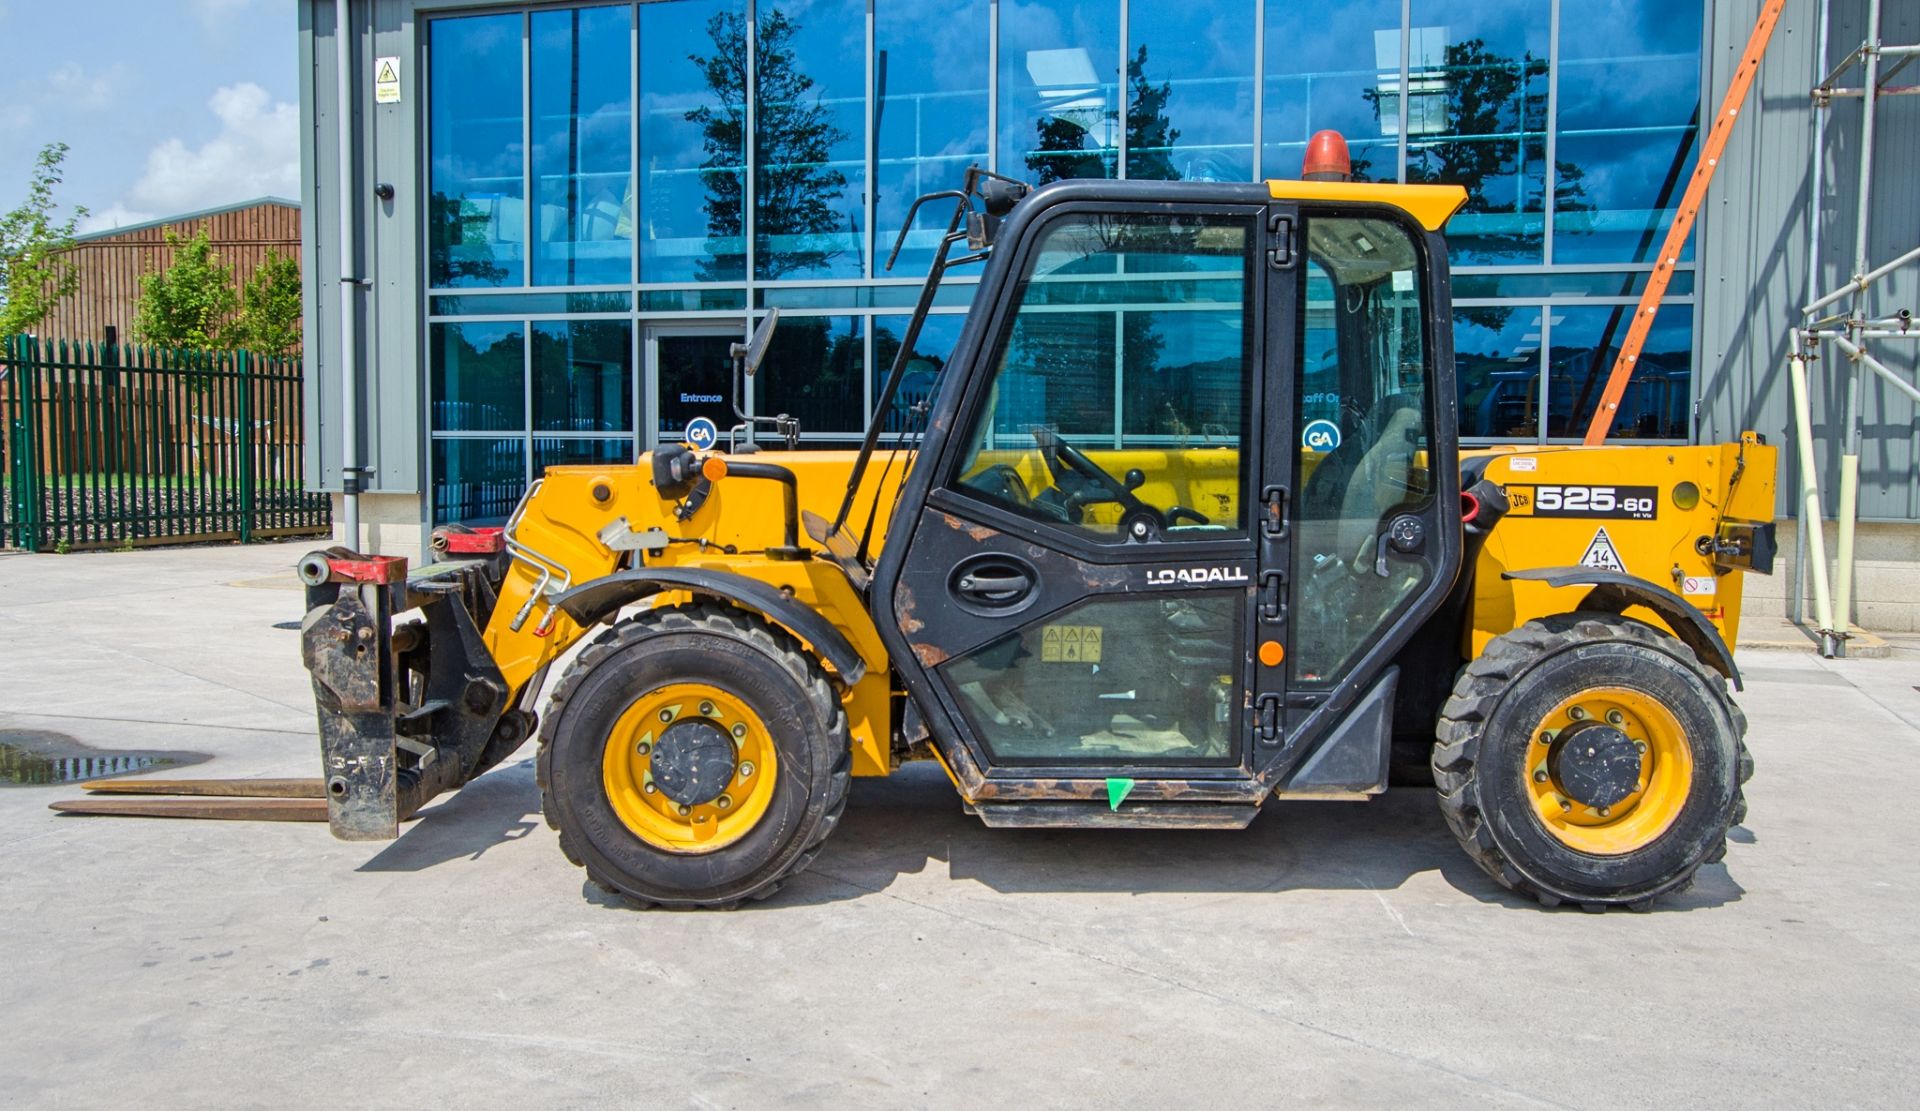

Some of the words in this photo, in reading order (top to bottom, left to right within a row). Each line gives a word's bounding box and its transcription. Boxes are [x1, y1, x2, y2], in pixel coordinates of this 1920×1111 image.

[680, 393, 723, 403] Entrance
[1304, 393, 1324, 404] aff
[690, 428, 711, 441] GA
[1308, 432, 1334, 447] GA
[1513, 494, 1529, 507] JCB
[1535, 486, 1653, 512] 525-60
[1592, 550, 1609, 564] 14
[1146, 567, 1249, 585] LOADALL
